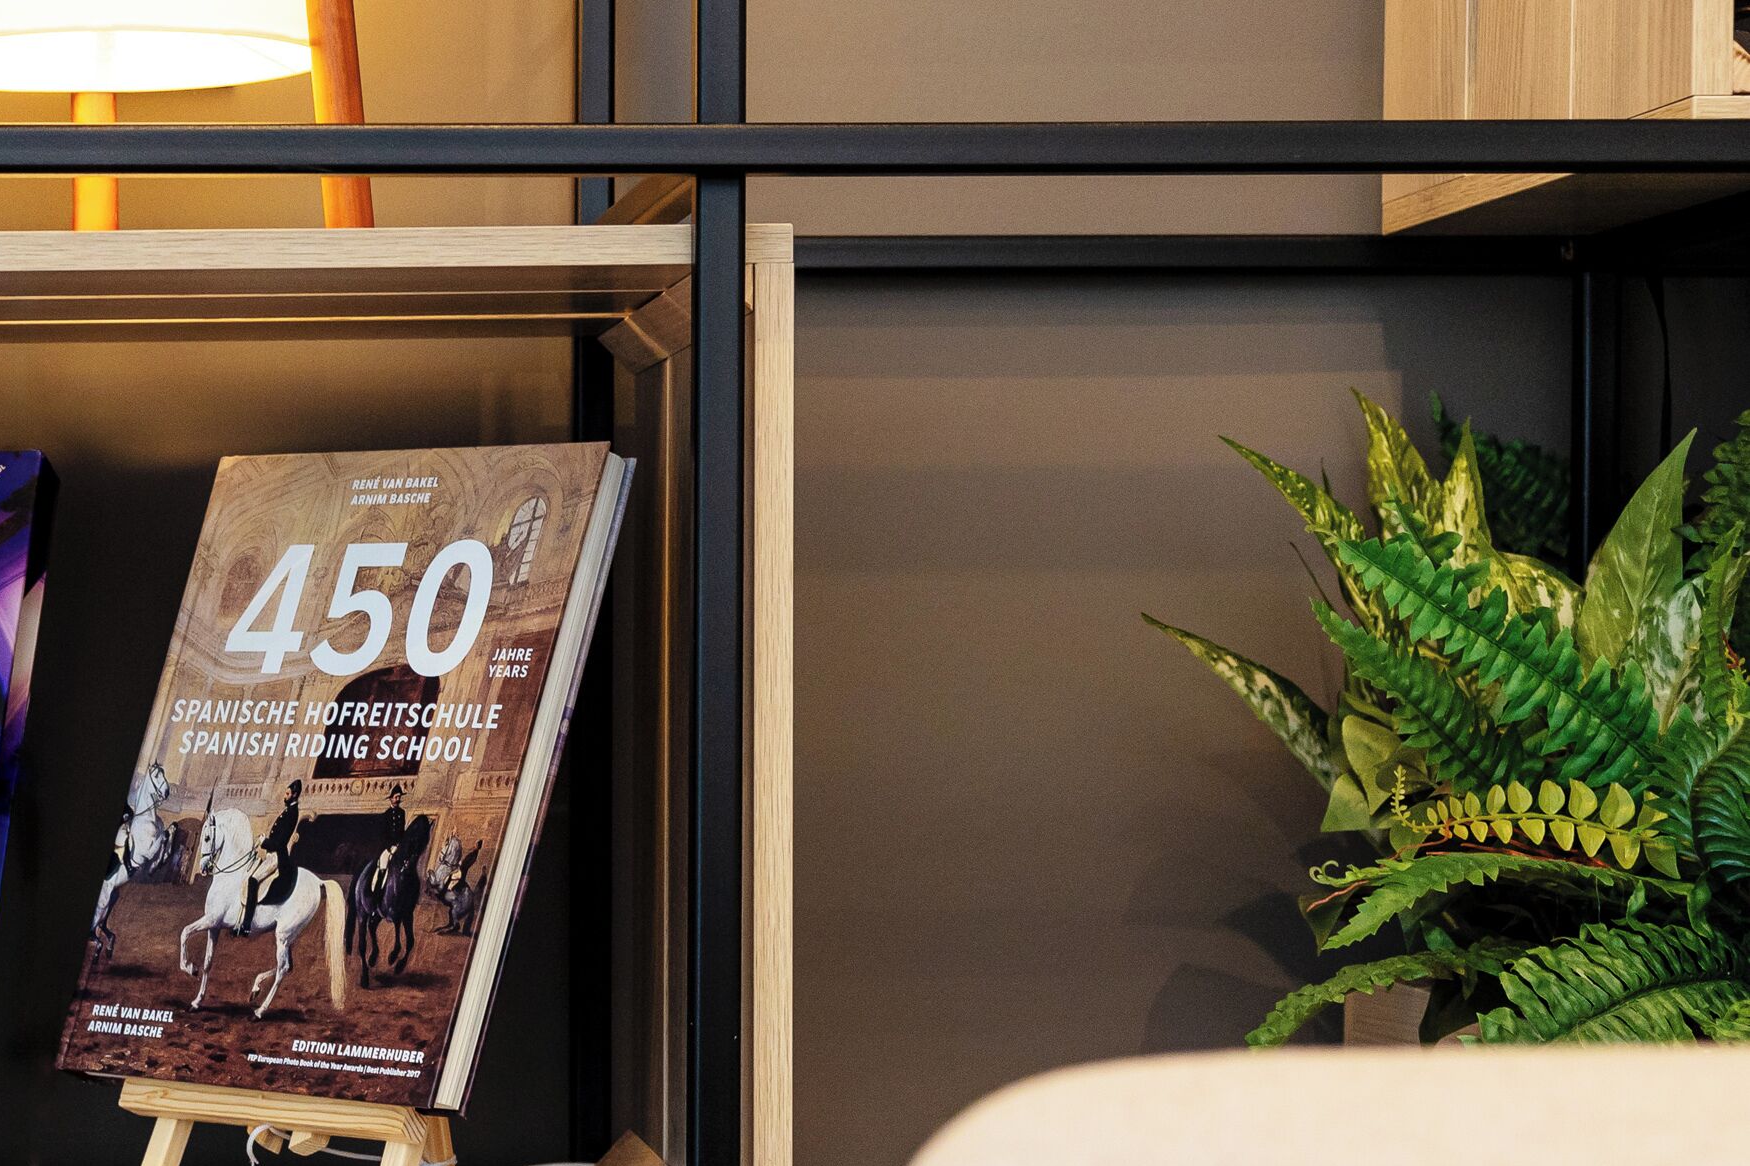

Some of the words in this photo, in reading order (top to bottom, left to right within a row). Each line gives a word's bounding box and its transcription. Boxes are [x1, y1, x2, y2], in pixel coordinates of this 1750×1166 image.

[352, 475, 381, 490] RENÉ
[382, 478, 404, 489] VAN
[405, 477, 439, 489] BAKEL
[350, 494, 388, 505] ARNIM
[389, 492, 432, 505] BASCHE
[224, 539, 493, 677] 450
[492, 648, 533, 662] JAHRE
[488, 664, 529, 678] YEARS
[170, 699, 299, 726] SPANISCHE
[303, 701, 503, 730] HOFREITSCHULE
[178, 730, 285, 757] SPANISH
[287, 733, 370, 759] RIDING
[375, 736, 473, 762] SCHOOL
[91, 1003, 120, 1018] RENÉ
[120, 1006, 142, 1020] VAN
[141, 1008, 174, 1022] BAKEL
[87, 1020, 123, 1035] ARNIM
[123, 1023, 164, 1038] BASCHE
[258, 1054, 284, 1065] European
[283, 1057, 300, 1066] Photo
[292, 1040, 336, 1056] EDITION
[337, 1044, 425, 1064] LAMMERHUBER
